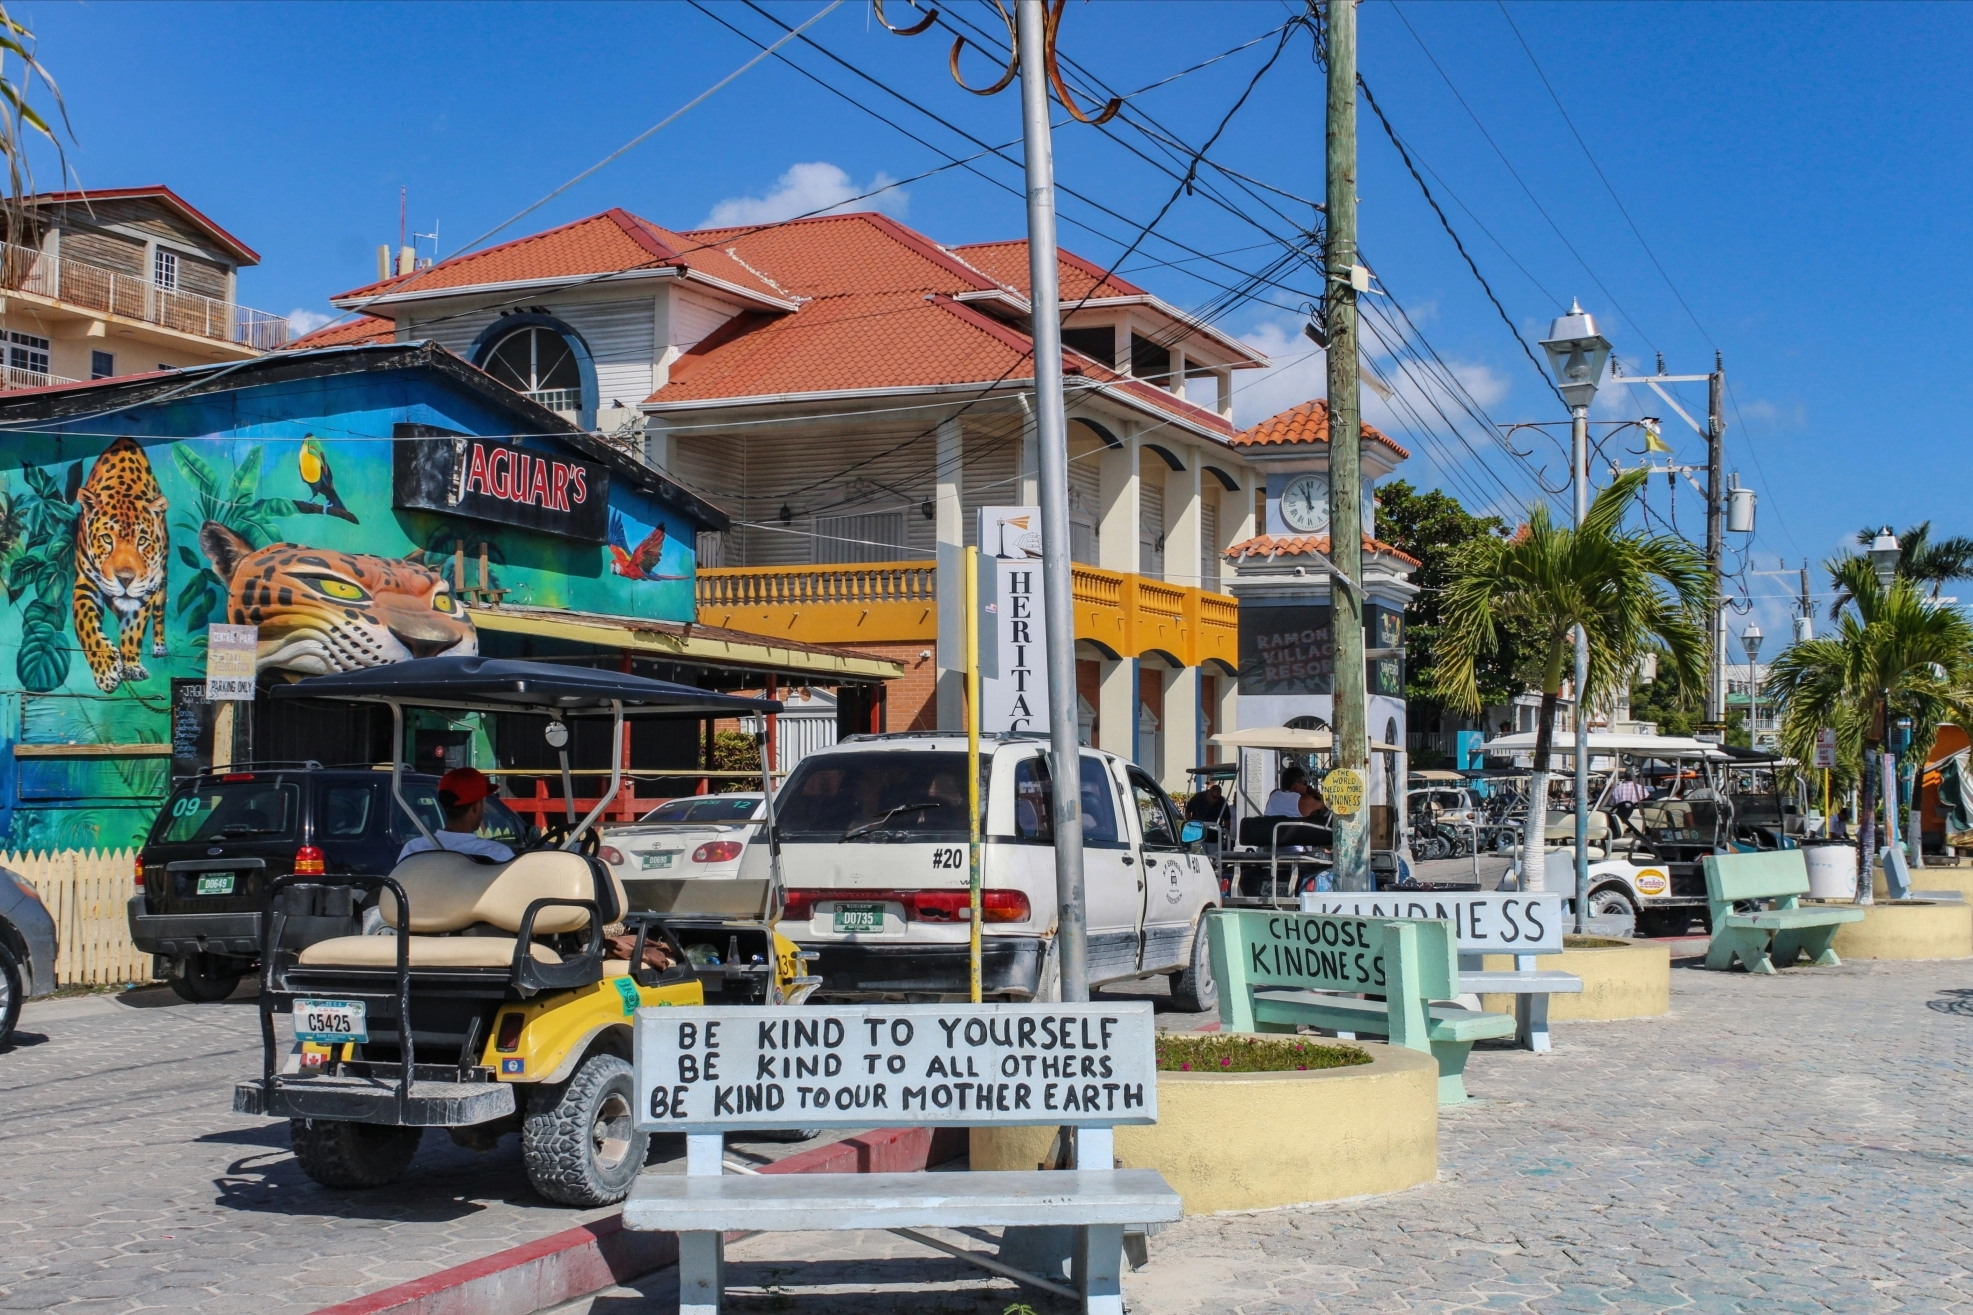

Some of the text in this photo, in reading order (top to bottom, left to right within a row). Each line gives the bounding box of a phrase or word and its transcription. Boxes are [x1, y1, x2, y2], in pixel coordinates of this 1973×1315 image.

[239, 633, 256, 645] PARK
[211, 681, 252, 693] PARKING ONLY
[1324, 785, 1344, 793] NEEDS
[1332, 777, 1356, 785] WORLD
[173, 798, 201, 817] 09
[732, 800, 751, 809] 12
[933, 848, 963, 869] #20
[1269, 917, 1371, 948] CHOOSE
[776, 954, 789, 975] 13
[1251, 942, 1386, 986] KINDNESS
[308, 1013, 351, 1033] C5425
[678, 1016, 1119, 1050] BE KIND TO YOURSELF
[678, 1051, 1113, 1084] BE KIND TO ALL OTHERS
[650, 1082, 1143, 1119] BE KIND TO OUR MOTHER EARTH
